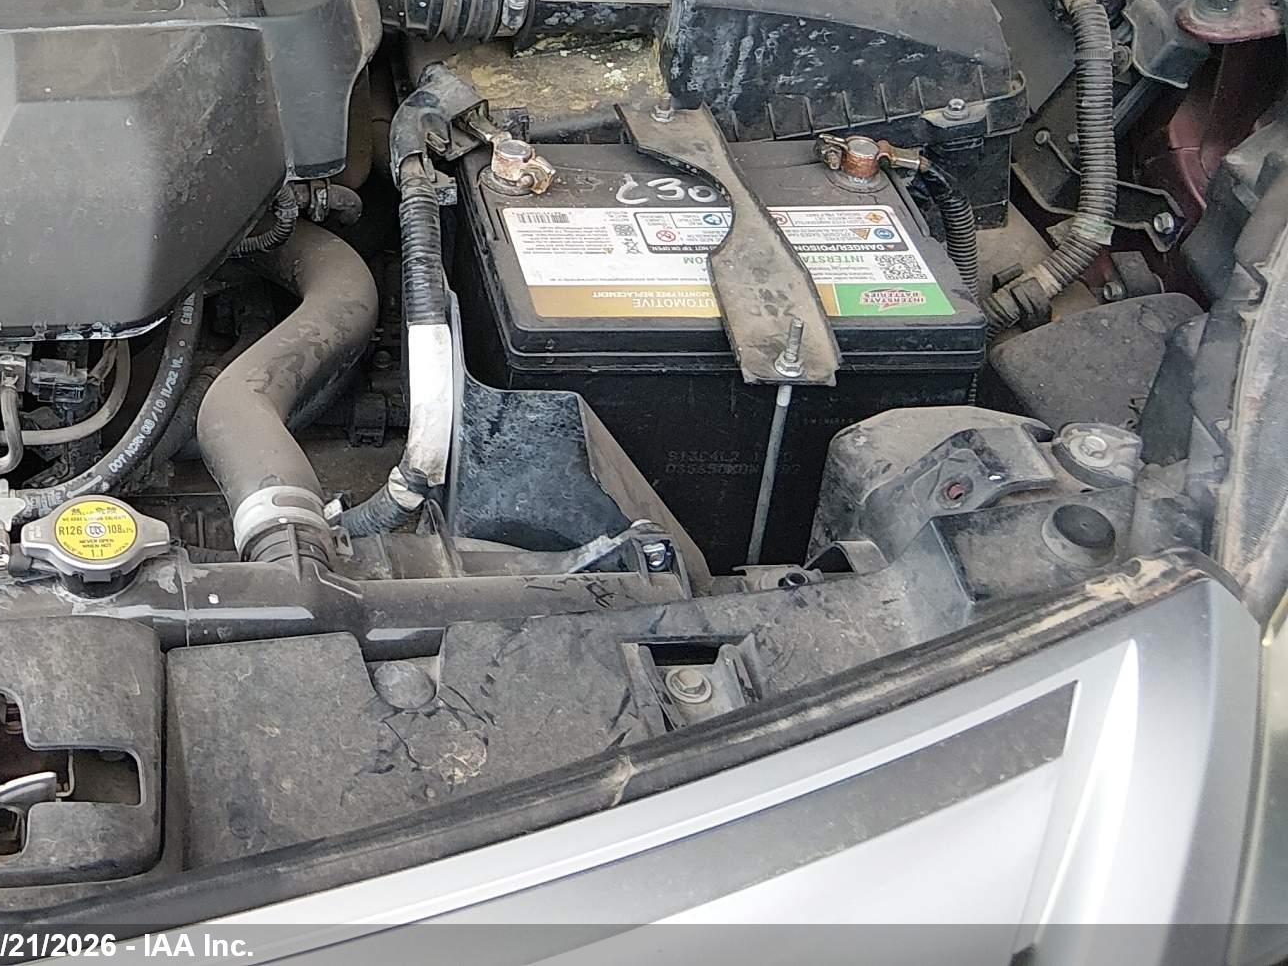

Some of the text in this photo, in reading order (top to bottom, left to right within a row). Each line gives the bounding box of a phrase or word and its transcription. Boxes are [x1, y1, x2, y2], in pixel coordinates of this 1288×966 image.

[803, 255, 865, 263] INTERSTA
[592, 290, 654, 298] REPLACEMENT
[632, 298, 714, 308] UTOMOTIVE
[58, 526, 83, 535] R126
